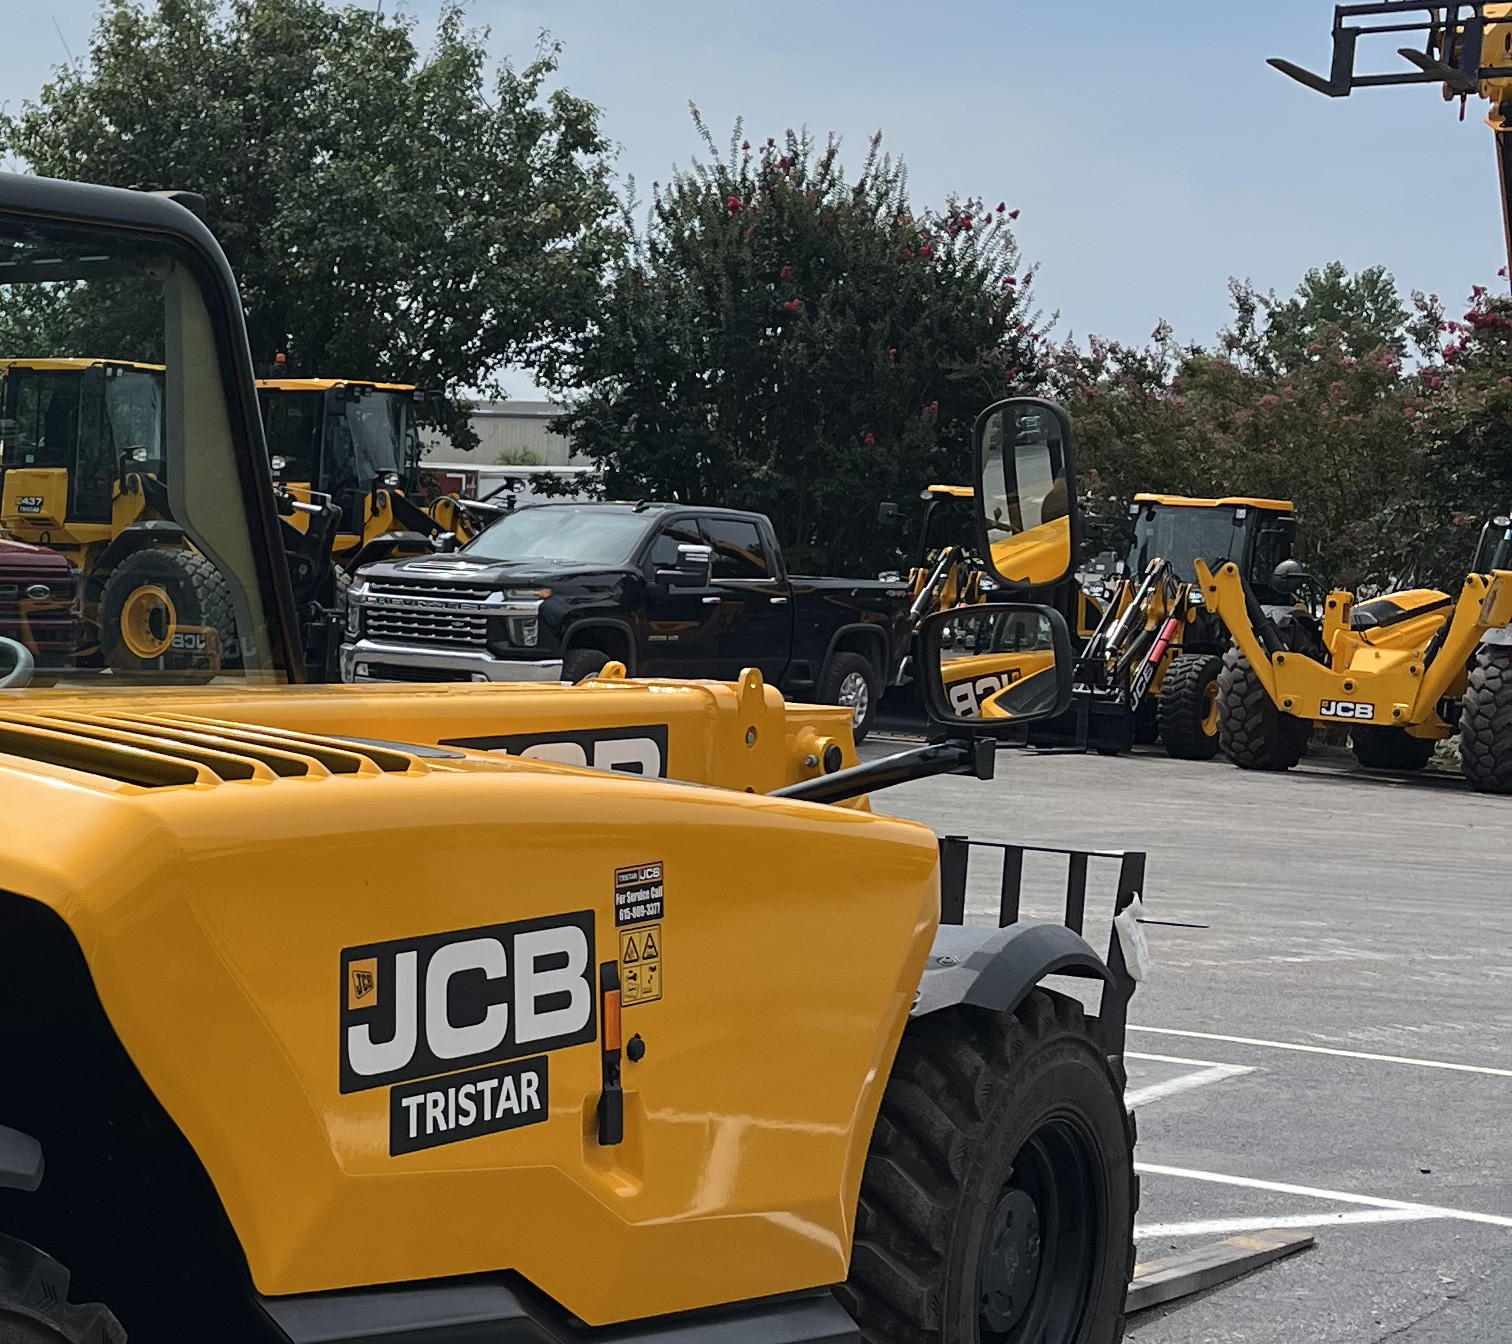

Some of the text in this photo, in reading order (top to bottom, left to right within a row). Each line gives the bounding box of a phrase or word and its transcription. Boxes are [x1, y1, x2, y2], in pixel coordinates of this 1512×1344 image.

[22, 497, 43, 506] 437
[1130, 663, 1154, 712] JCB
[1321, 701, 1374, 719] JCB
[347, 925, 592, 1077] JCB
[400, 1070, 542, 1139] TRISTAR
